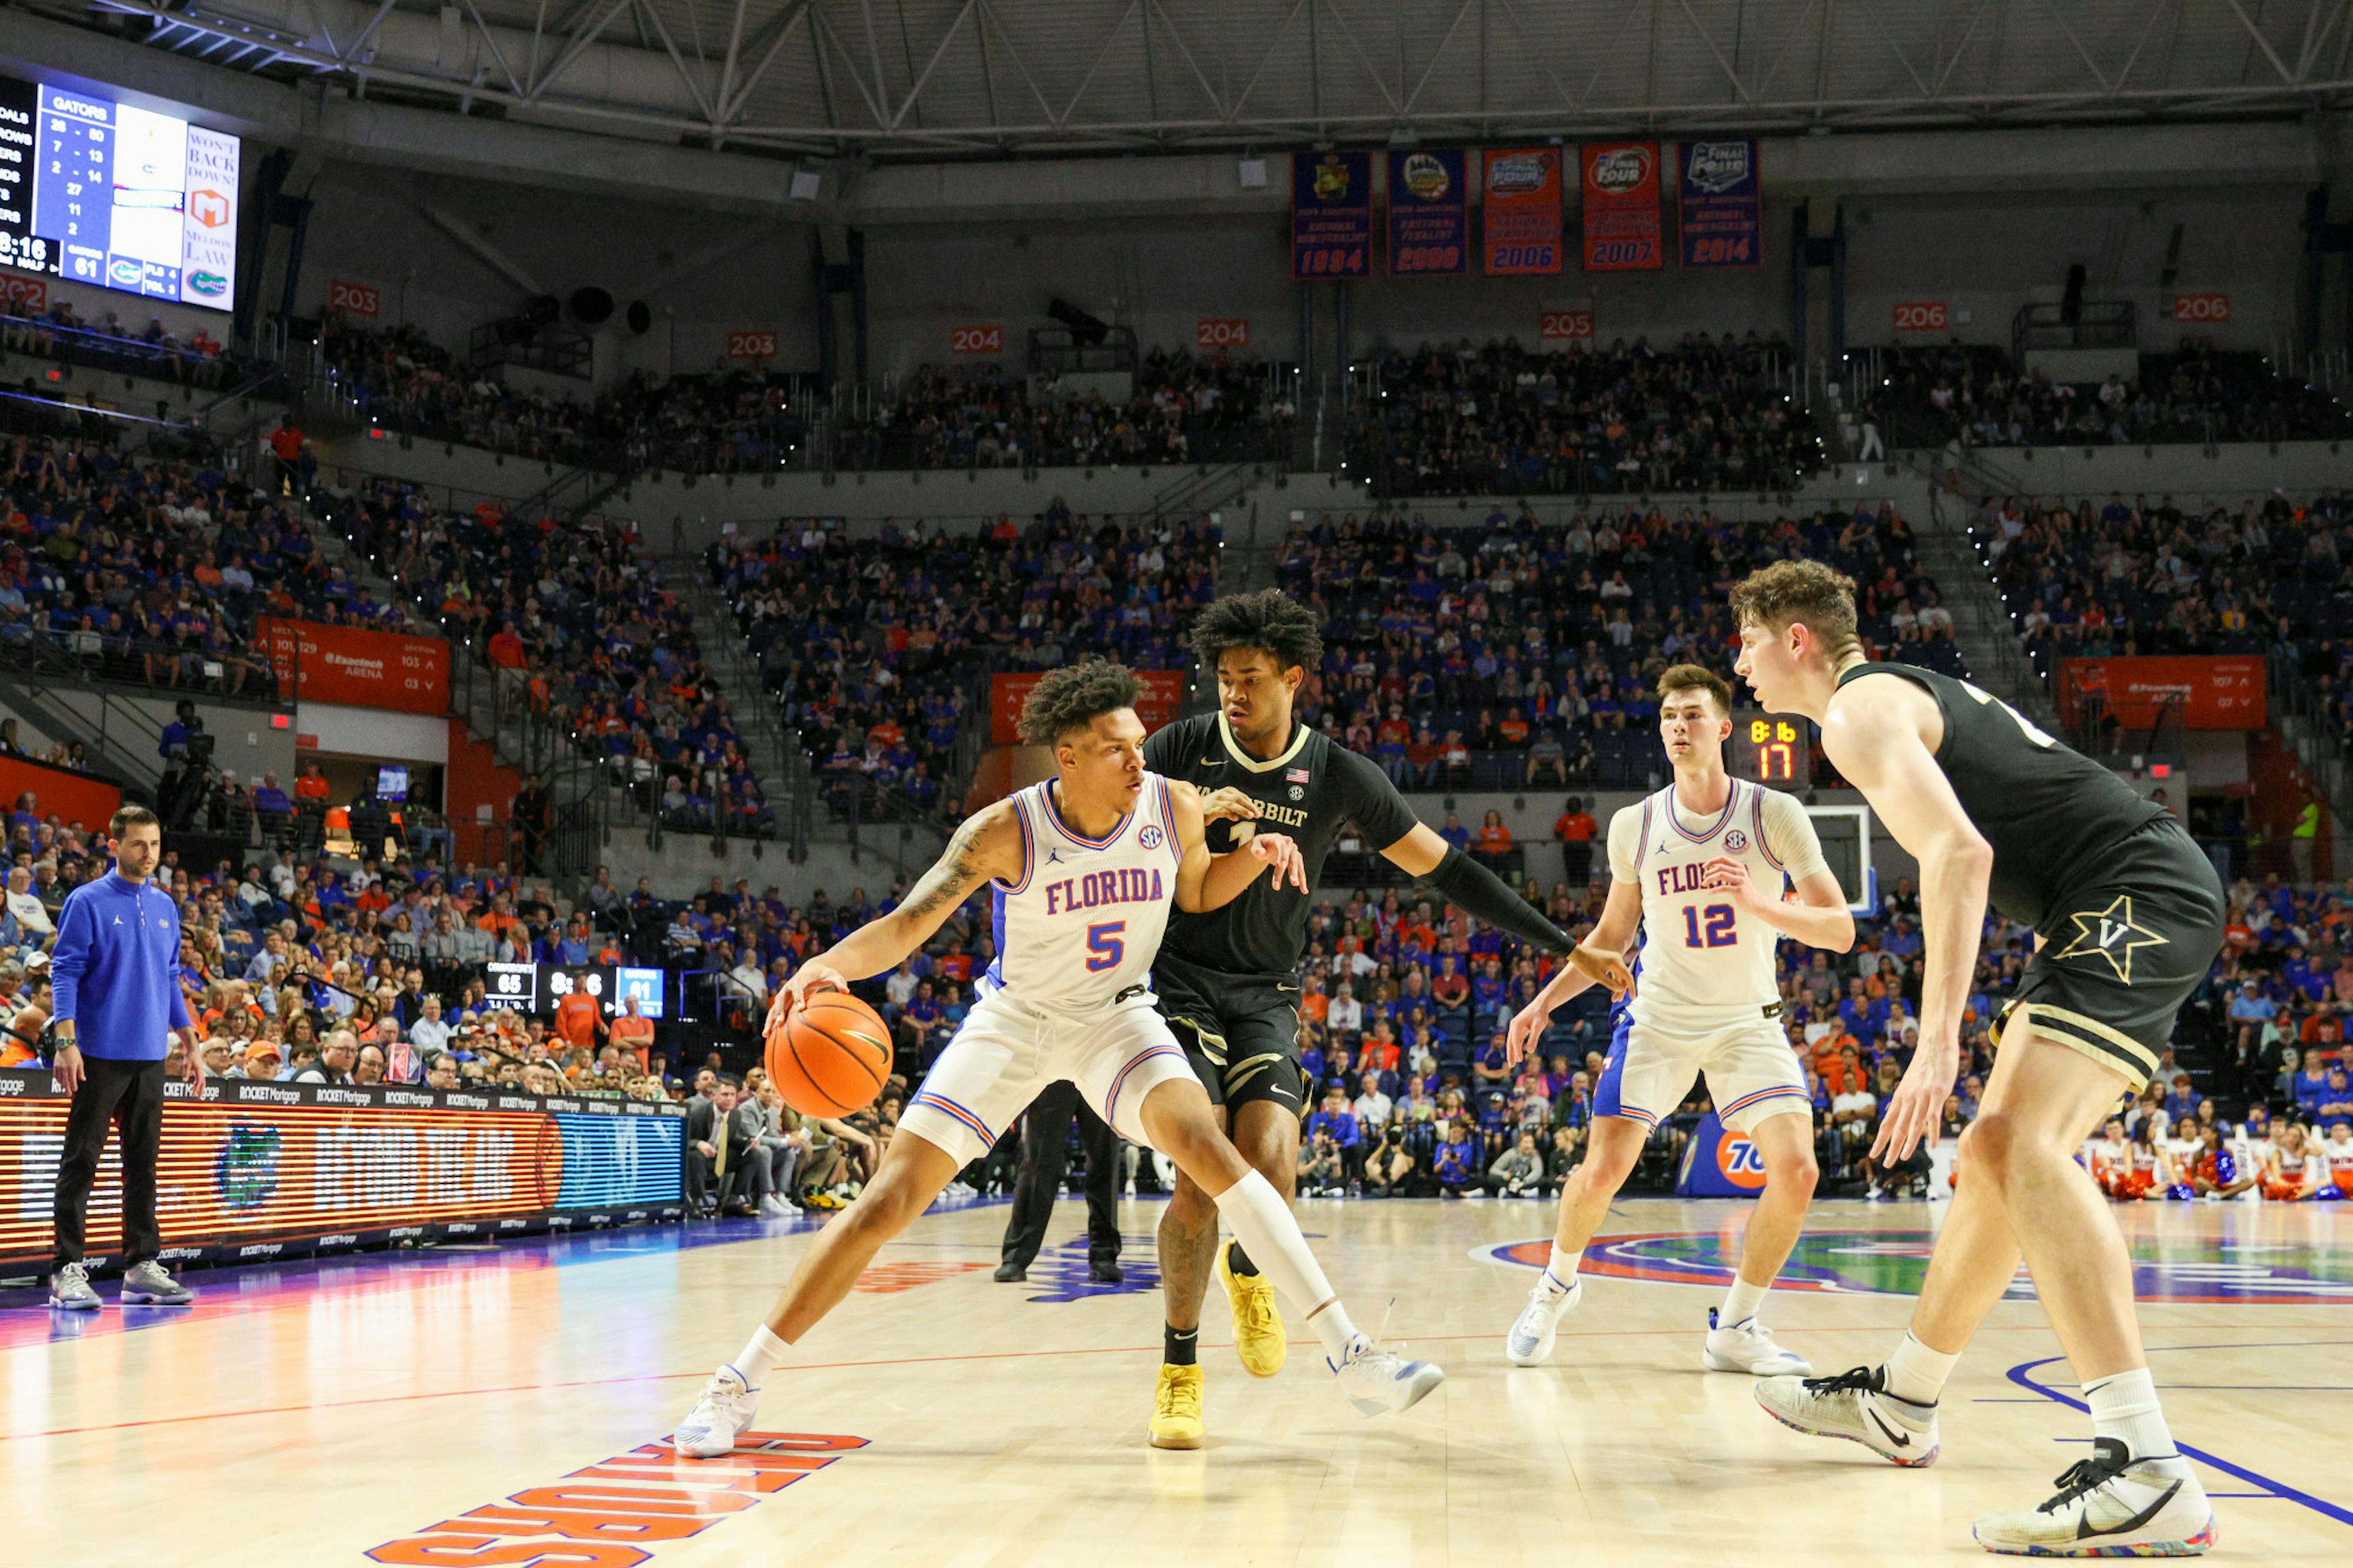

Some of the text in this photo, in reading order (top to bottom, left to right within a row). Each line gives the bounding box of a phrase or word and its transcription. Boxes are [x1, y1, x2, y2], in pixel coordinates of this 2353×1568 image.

[53, 96, 108, 121] GATORS
[54, 140, 62, 152] 7
[51, 161, 61, 174] 2
[189, 148, 234, 172] BACK
[68, 202, 81, 216] 11
[68, 222, 77, 235] 2
[185, 241, 230, 267] LAW
[1301, 249, 1362, 273] 1994
[1494, 245, 1554, 269] 2006
[1593, 242, 1652, 263] 2007
[1692, 238, 1750, 263] 2014
[75, 257, 97, 278] 61
[332, 286, 378, 313] 203
[2177, 297, 2228, 319] 206
[1543, 315, 1589, 335] 205
[1895, 306, 1944, 328] 206
[952, 329, 999, 351] 204
[1200, 323, 1245, 343] 204
[731, 335, 775, 355] 203
[299, 642, 317, 654] 129
[401, 655, 419, 668] 103
[345, 666, 384, 680] ARENA
[404, 678, 419, 690] 03
[1751, 720, 1797, 743] 8:16
[1761, 743, 1791, 779] 17
[1140, 827, 1161, 848] SEC
[1726, 830, 1745, 849] SEC
[1045, 868, 1164, 915] FLORIDA
[1682, 903, 1738, 949] 12
[2098, 918, 2129, 949] V
[1085, 920, 1126, 973] 5
[498, 973, 522, 993] 65
[551, 971, 602, 996] 8:6
[239, 1086, 301, 1105] ROCKET Mortgage
[317, 1089, 371, 1106] ROCKET Mortgage
[385, 1092, 434, 1107] ROCKET Mortgage
[447, 1095, 468, 1106] ROCKET
[499, 1097, 518, 1109] ROCKET
[239, 1243, 283, 1257] ROCKET Mortgage
